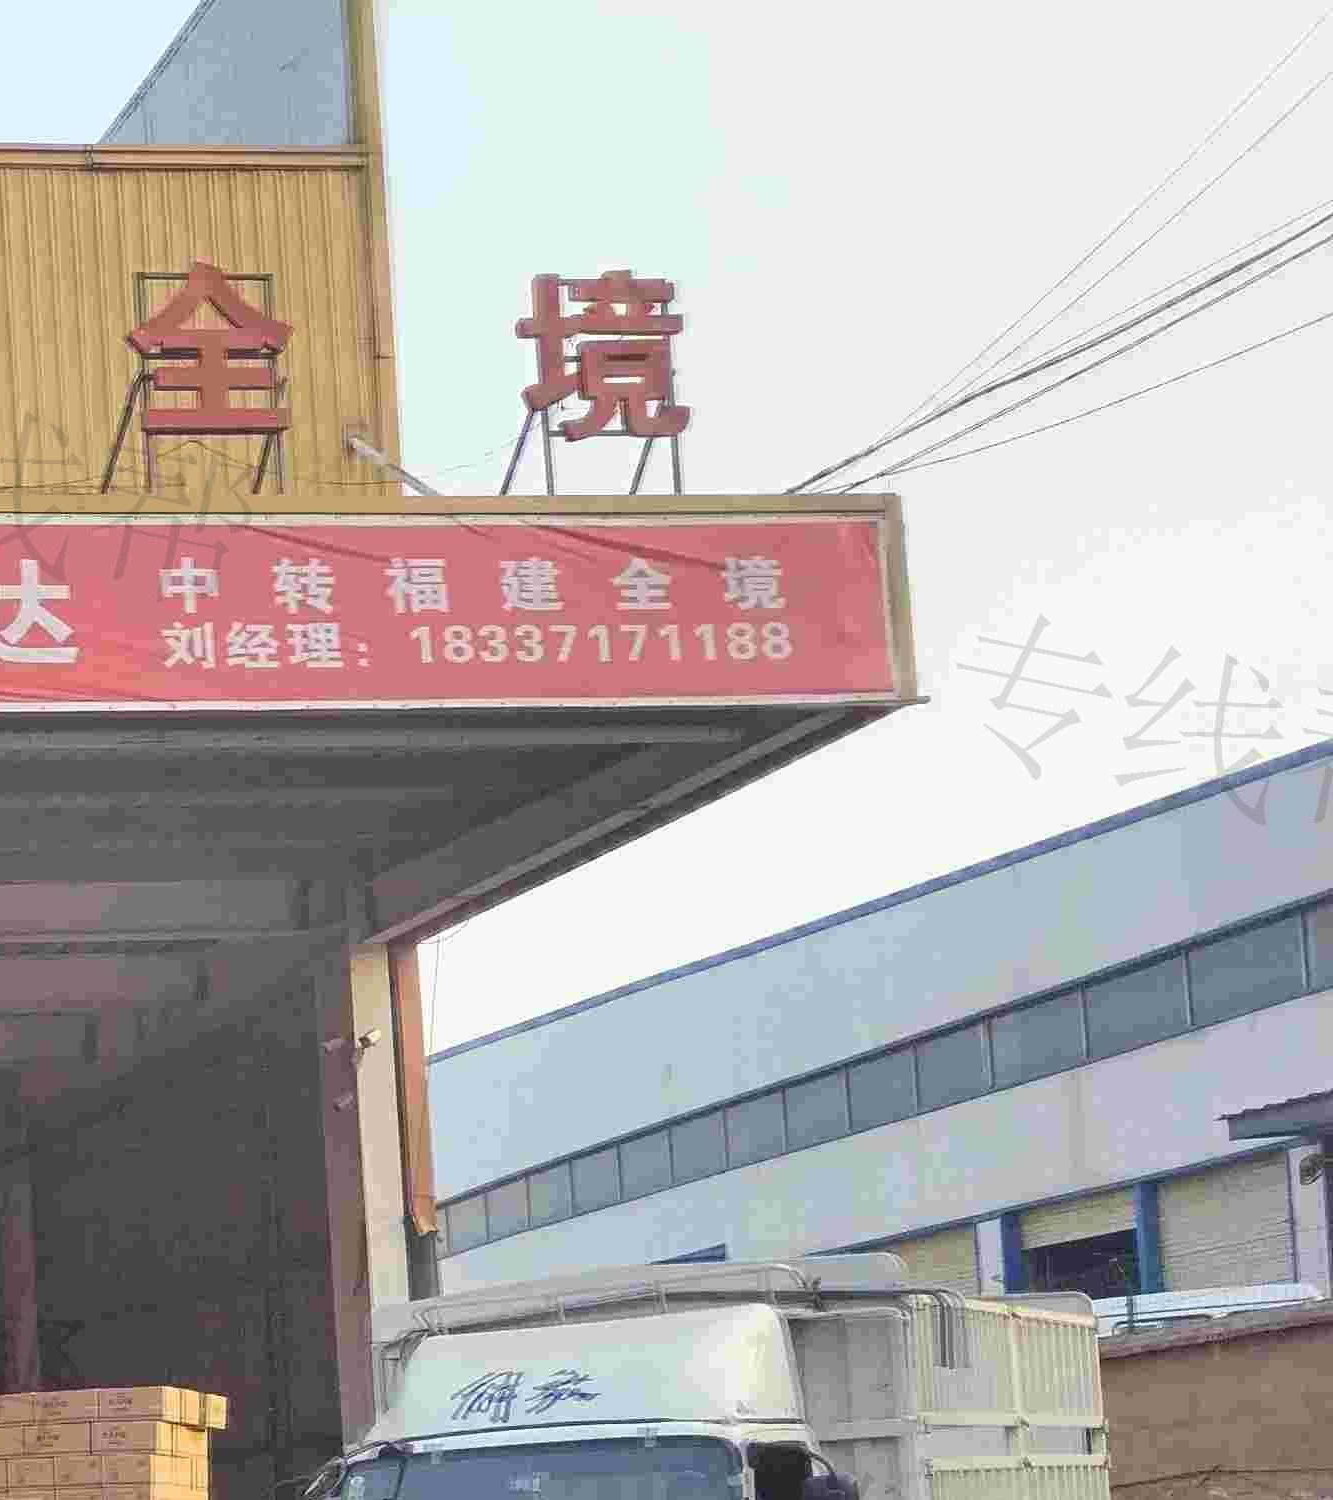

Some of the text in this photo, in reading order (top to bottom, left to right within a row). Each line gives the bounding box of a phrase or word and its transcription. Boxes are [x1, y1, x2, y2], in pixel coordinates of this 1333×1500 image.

[160, 557, 786, 615] 中转福建全境
